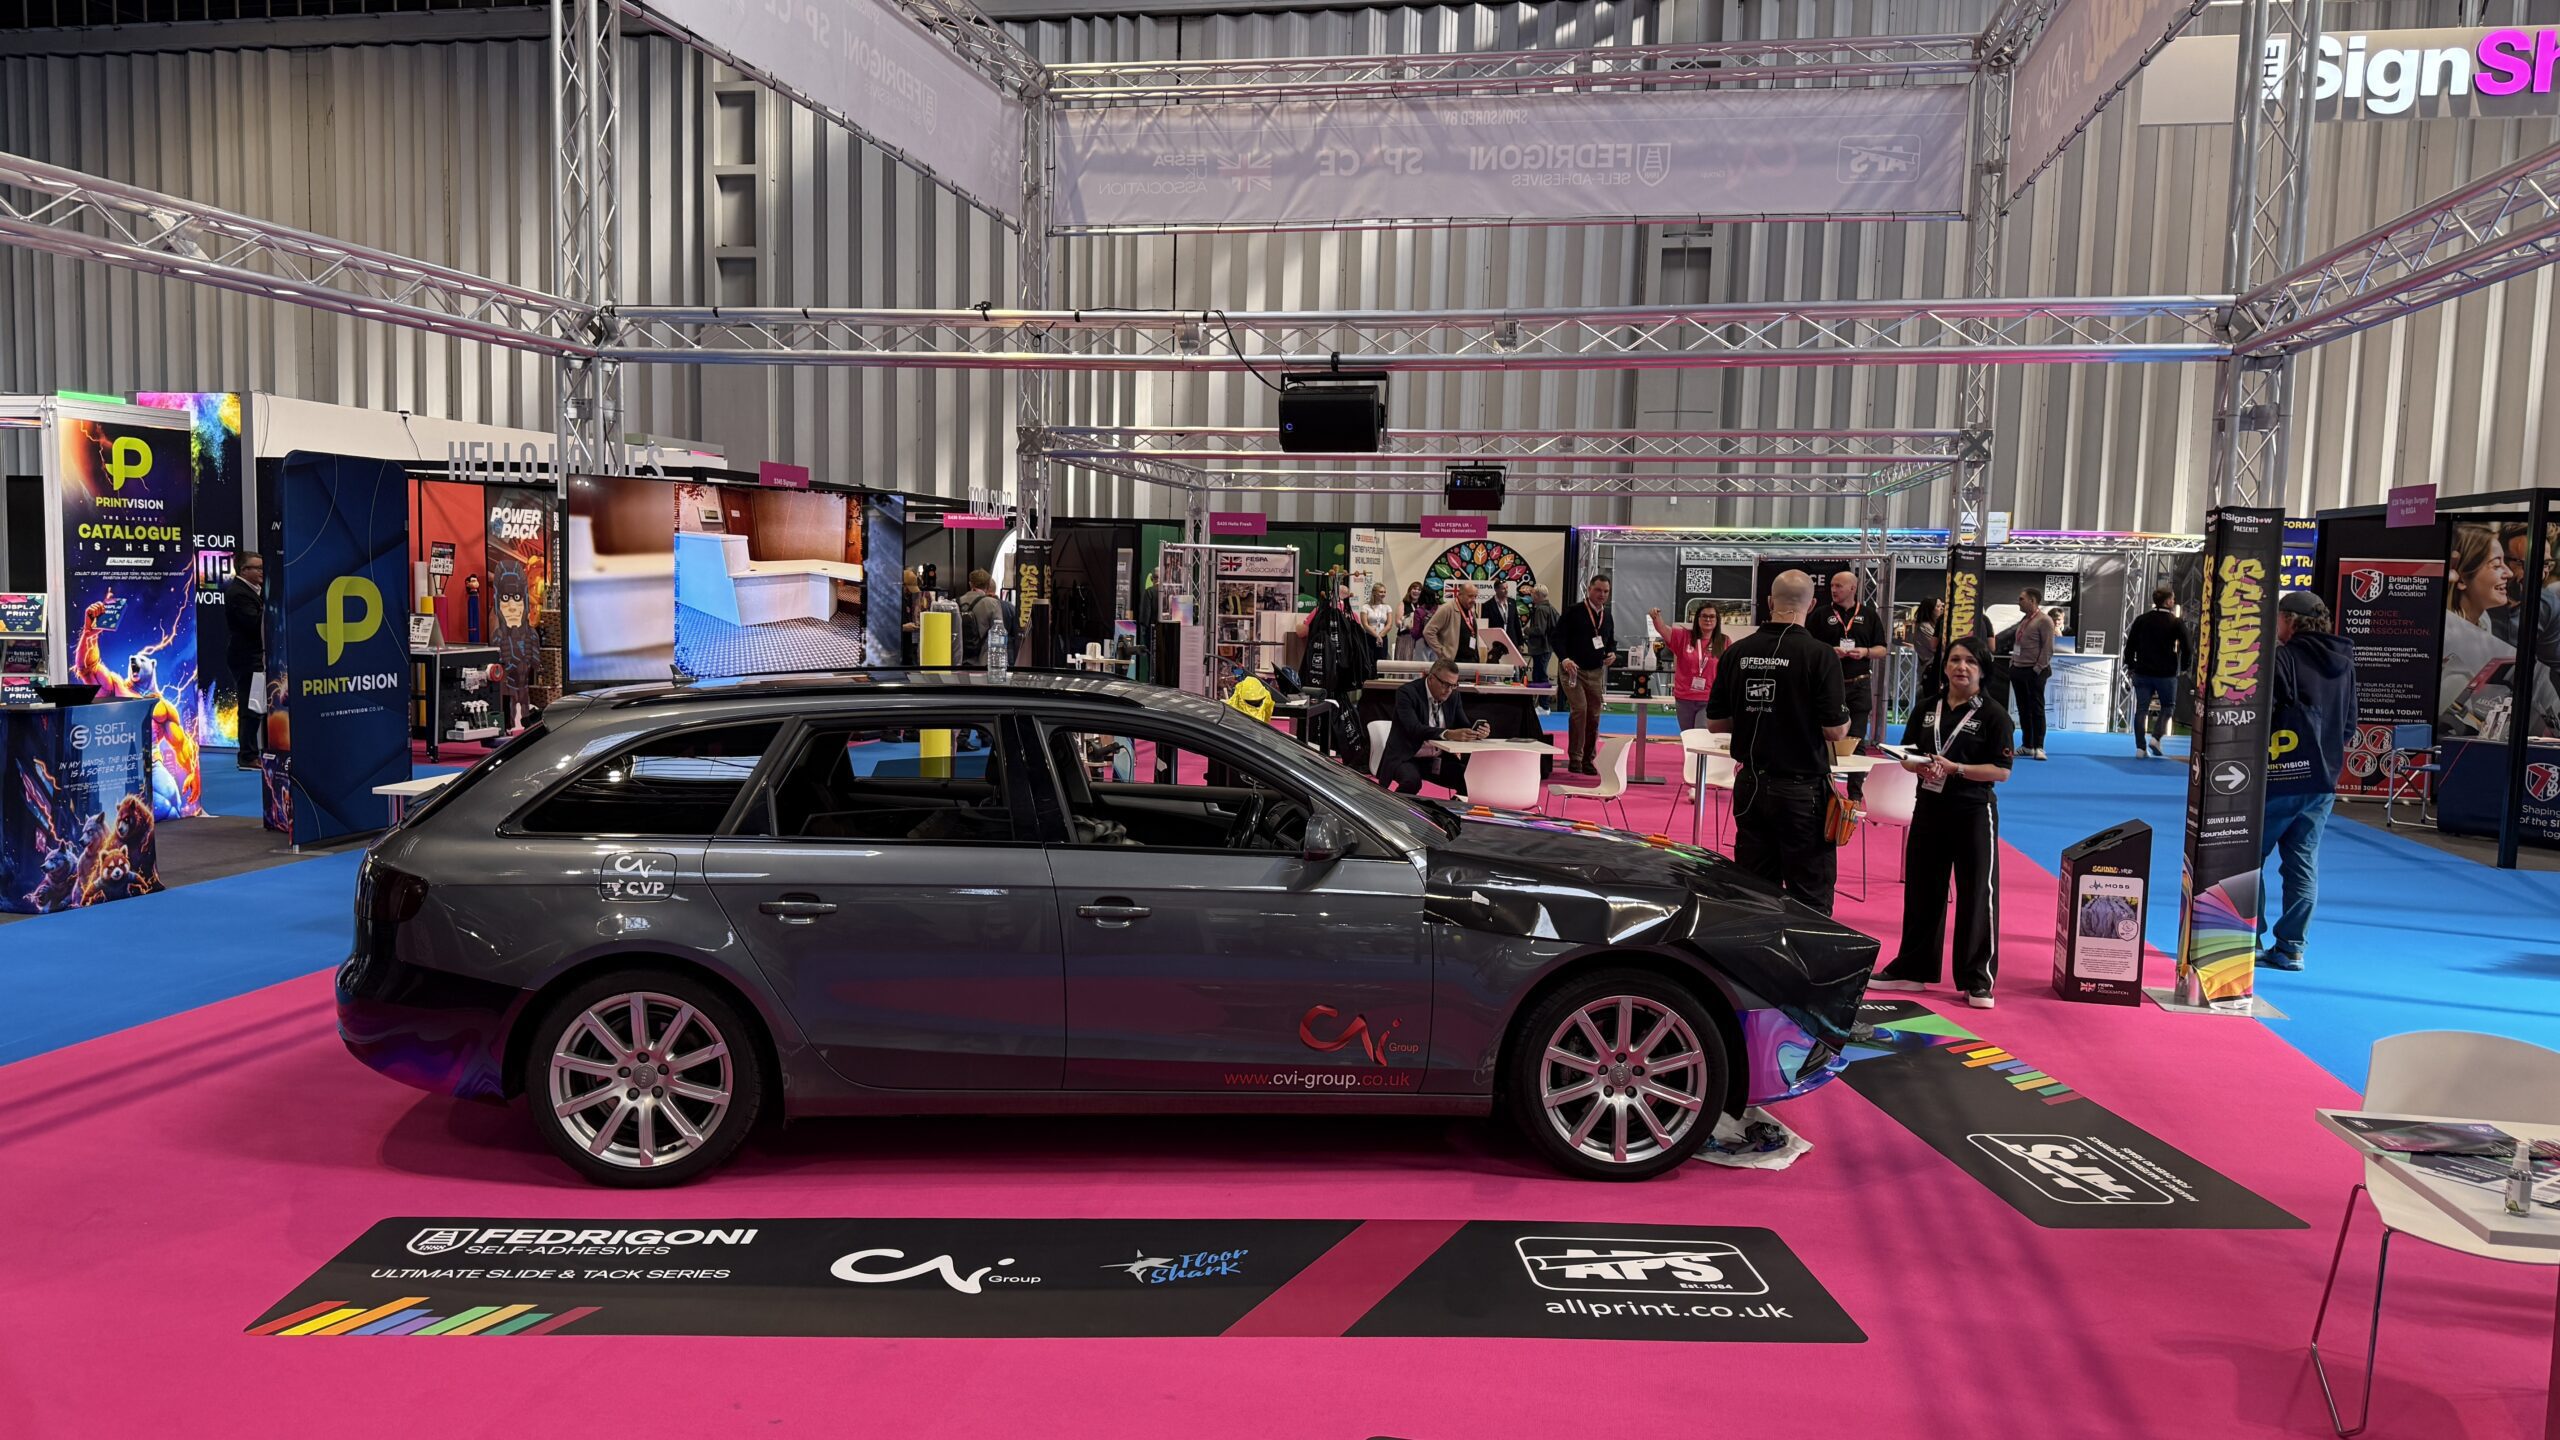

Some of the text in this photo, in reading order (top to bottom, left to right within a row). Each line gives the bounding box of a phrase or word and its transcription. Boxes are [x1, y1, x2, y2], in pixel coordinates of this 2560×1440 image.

[448, 442, 665, 483] HELLO HAES
[96, 497, 164, 510] PRINTVISION
[969, 487, 1012, 518] TOOLSHOP
[491, 507, 542, 525] POWER
[78, 524, 182, 541] CATALOGUE
[501, 524, 539, 540] PACK
[2233, 525, 2259, 533] PRESENTS
[126, 543, 182, 553] HERE
[207, 535, 235, 548] OUR
[1913, 556, 1947, 564] TRUST
[1245, 566, 1291, 574] ASSOCIATION
[2413, 576, 2429, 584] Sign
[2395, 584, 2427, 592] Graphics
[2211, 555, 2265, 698] SCHOOL
[1749, 657, 1789, 667] FEDRIGONI
[303, 673, 398, 697] PRINTVISION
[2216, 710, 2256, 726] WRAP
[95, 722, 126, 735] SOFT
[95, 732, 136, 746] TOUCH
[2207, 817, 2224, 825] SOUND
[2532, 817, 2548, 826] the
[2200, 828, 2249, 838] Soundcheck
[626, 882, 664, 895] CVP
[1389, 1043, 1419, 1053] Group
[1224, 1071, 1409, 1089] www.cvi-group.co.uk
[475, 1229, 759, 1245] FEDRIGONI
[465, 1246, 670, 1255] SELF-ADHESIVES
[1179, 1248, 1249, 1270] Floor
[1565, 1249, 1723, 1282] APS
[370, 1269, 732, 1279] ULTIMATE SLIDE & TACK SERIES
[988, 1275, 1041, 1284] Group
[1545, 1299, 1794, 1319] allprint.co.uk
